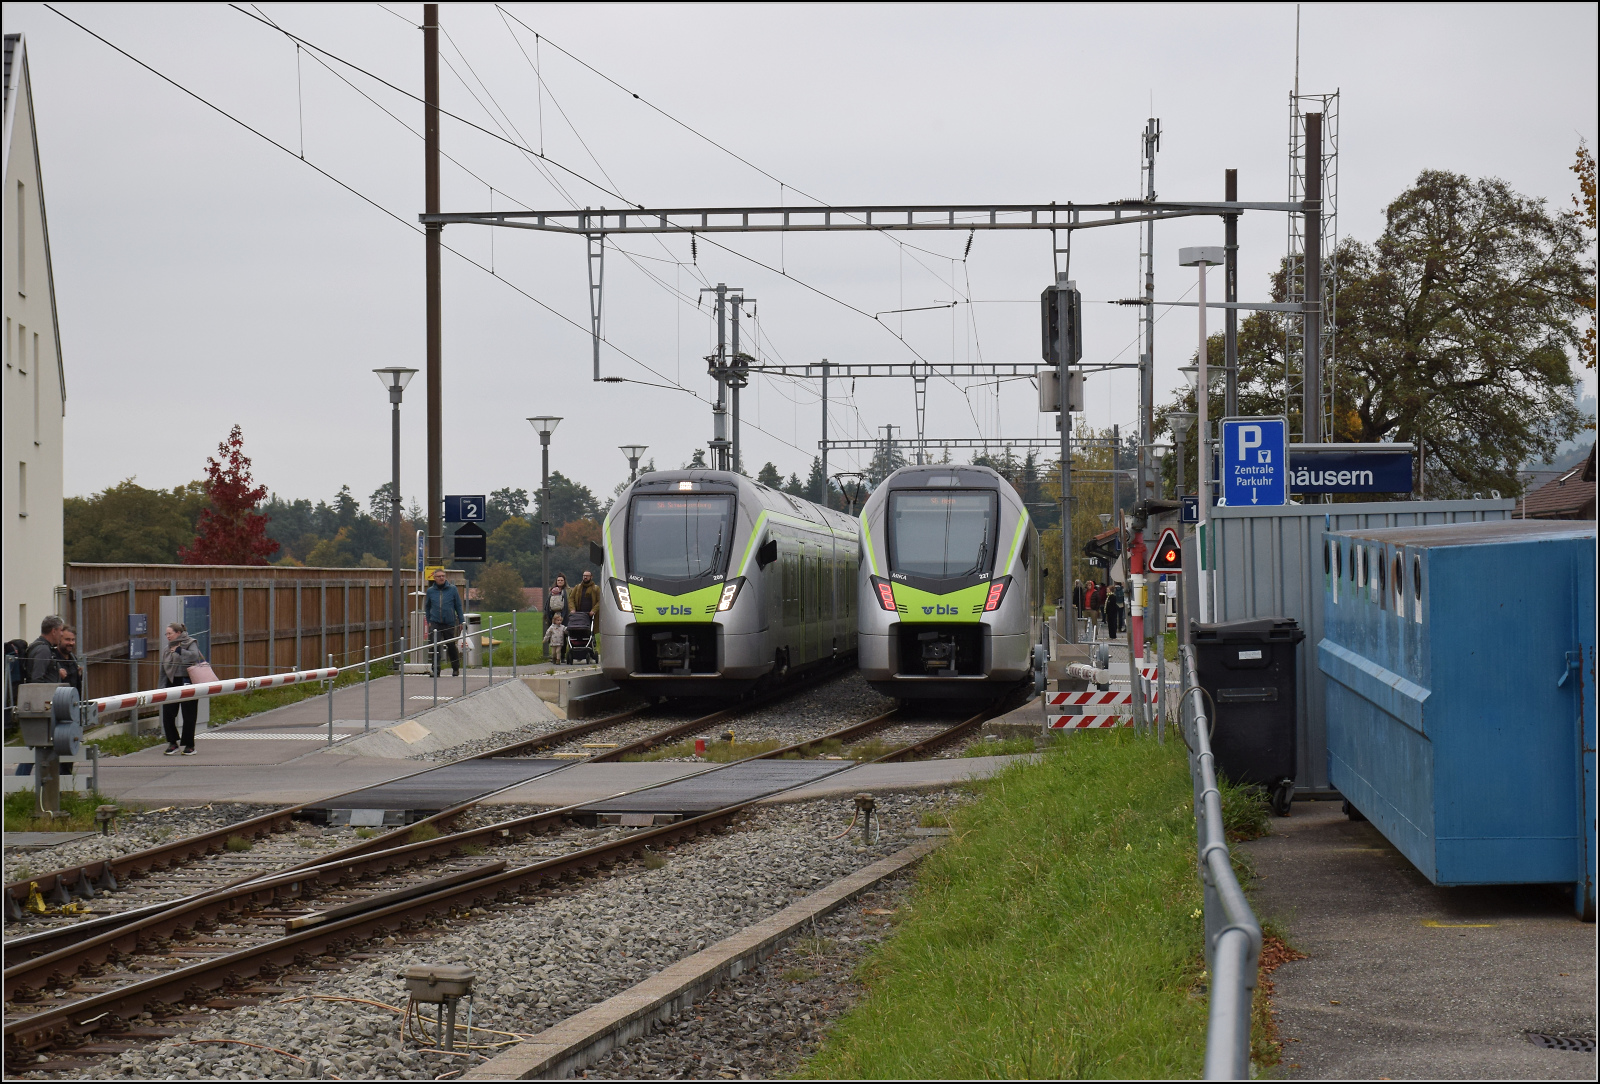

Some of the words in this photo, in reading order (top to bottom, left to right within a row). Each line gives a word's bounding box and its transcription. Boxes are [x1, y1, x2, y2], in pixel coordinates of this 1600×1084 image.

[1238, 425, 1262, 460] P
[1235, 464, 1274, 474] Zentrale
[1236, 476, 1273, 487] Parkuhr
[467, 504, 476, 517] 2
[1191, 505, 1197, 518] 1
[670, 605, 692, 615] bls
[936, 604, 958, 615] bls
